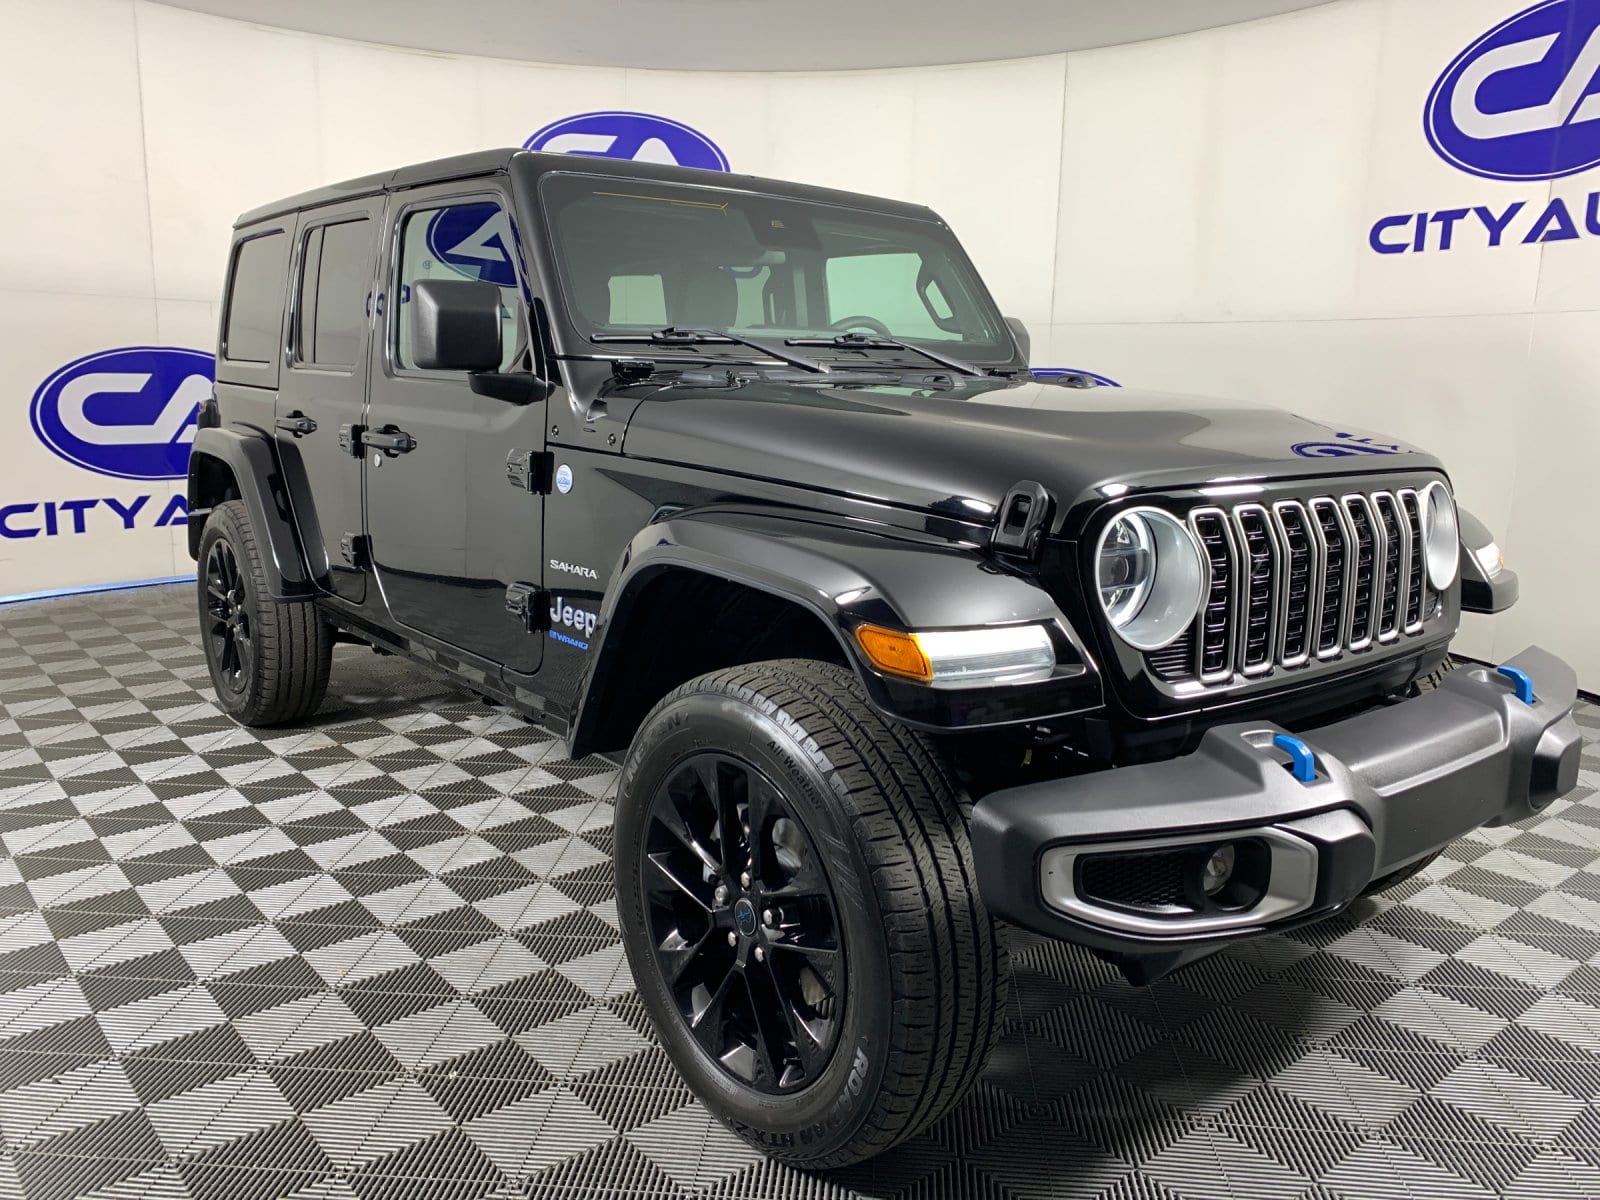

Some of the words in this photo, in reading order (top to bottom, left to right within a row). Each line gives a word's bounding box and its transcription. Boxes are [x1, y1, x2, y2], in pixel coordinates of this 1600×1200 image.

[1369, 201, 1528, 255] CITY
[0, 495, 152, 539] CITY
[549, 559, 598, 580] SAHARA
[549, 596, 597, 639] Jeep
[766, 740, 822, 810] All-Weather
